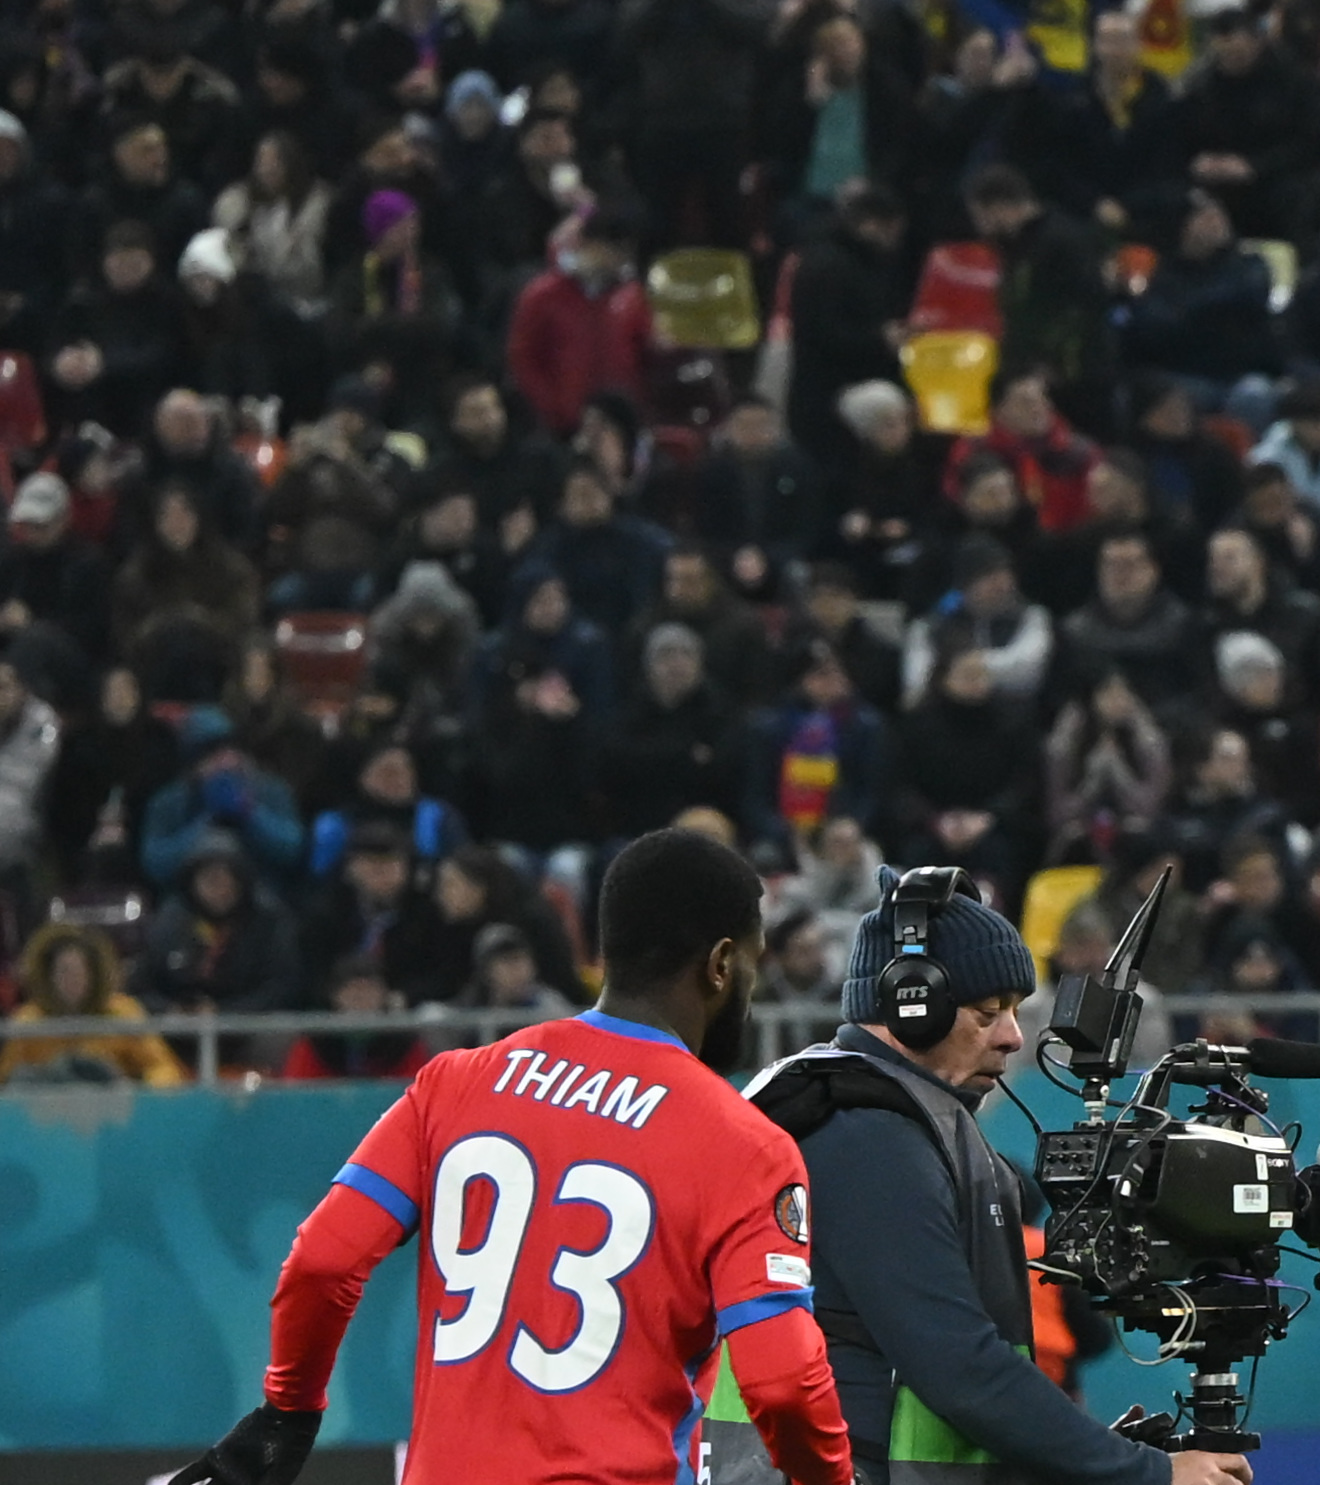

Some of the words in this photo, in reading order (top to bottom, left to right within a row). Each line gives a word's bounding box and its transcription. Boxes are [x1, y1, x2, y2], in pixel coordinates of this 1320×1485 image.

[896, 985, 928, 1000] RTS
[492, 1047, 669, 1131] THIAM
[1267, 1158, 1290, 1168] SOY
[430, 1131, 655, 1394] 93
